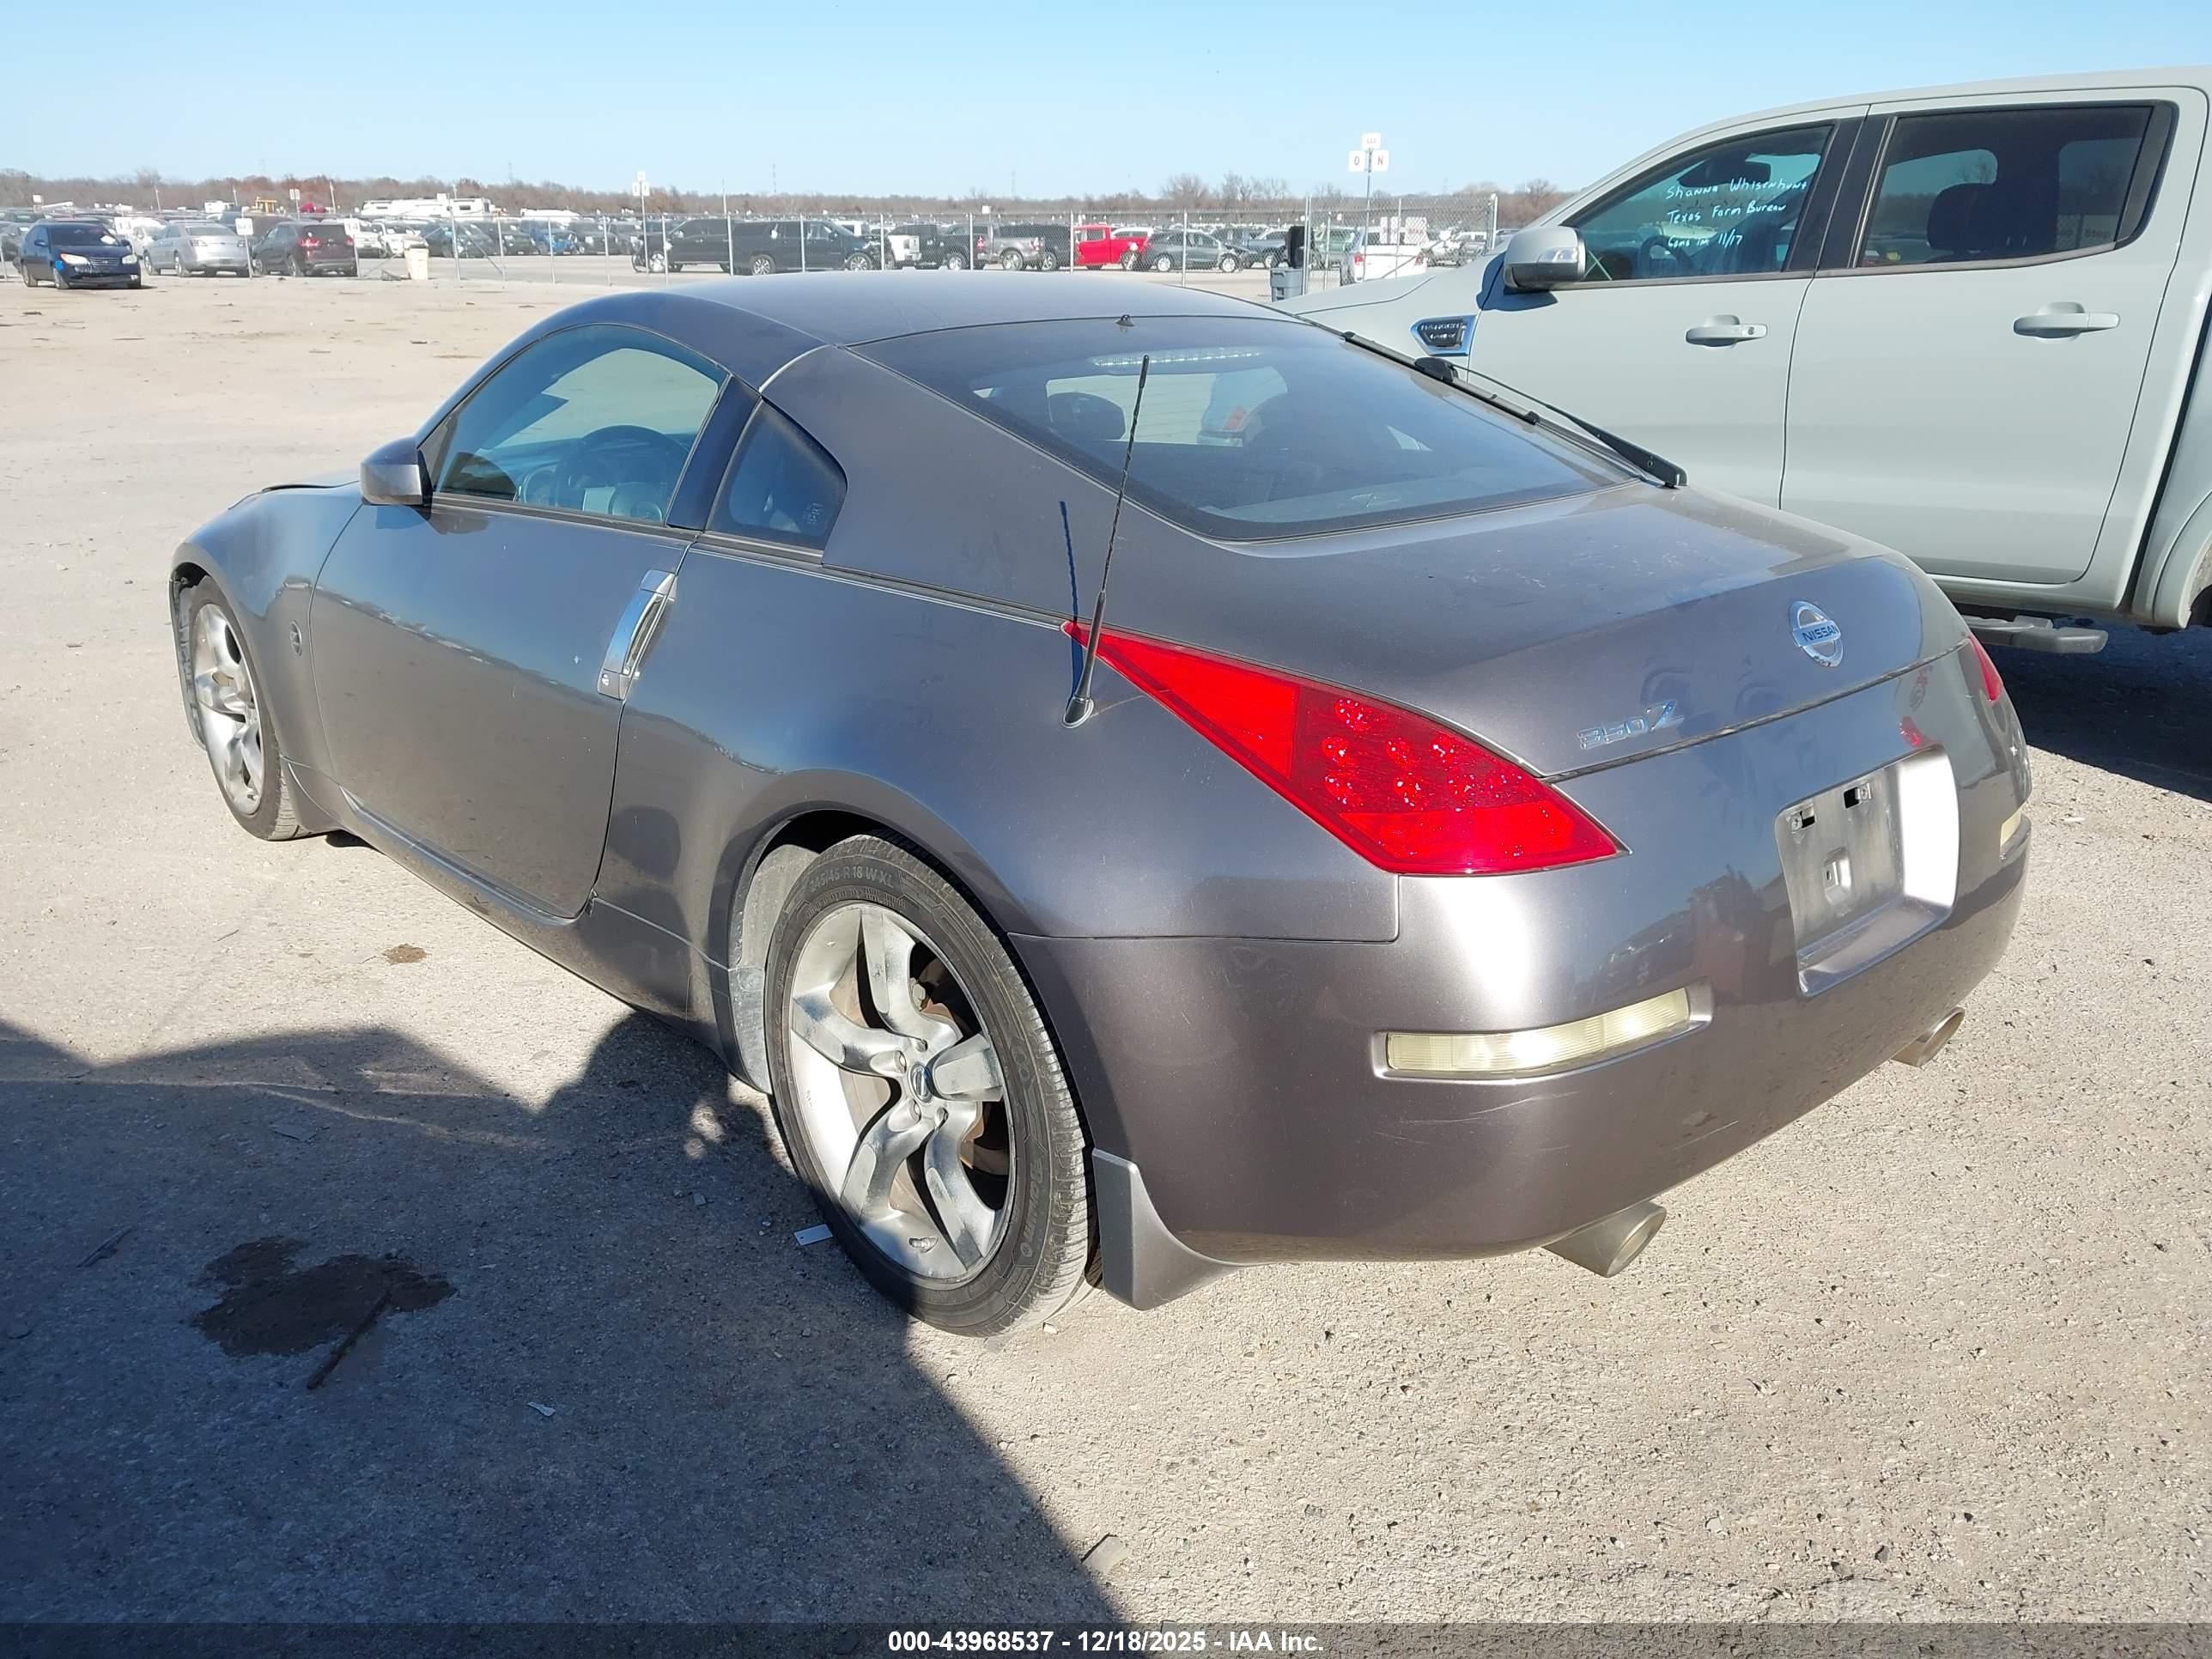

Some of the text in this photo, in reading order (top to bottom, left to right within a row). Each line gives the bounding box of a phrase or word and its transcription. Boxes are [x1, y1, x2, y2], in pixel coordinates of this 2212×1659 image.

[1667, 210, 1701, 225] Texas
[1746, 200, 1787, 214] Bureau
[1718, 228, 1743, 248] 11/17
[1802, 624, 1840, 642] NISSAN
[852, 866, 863, 879] 18
